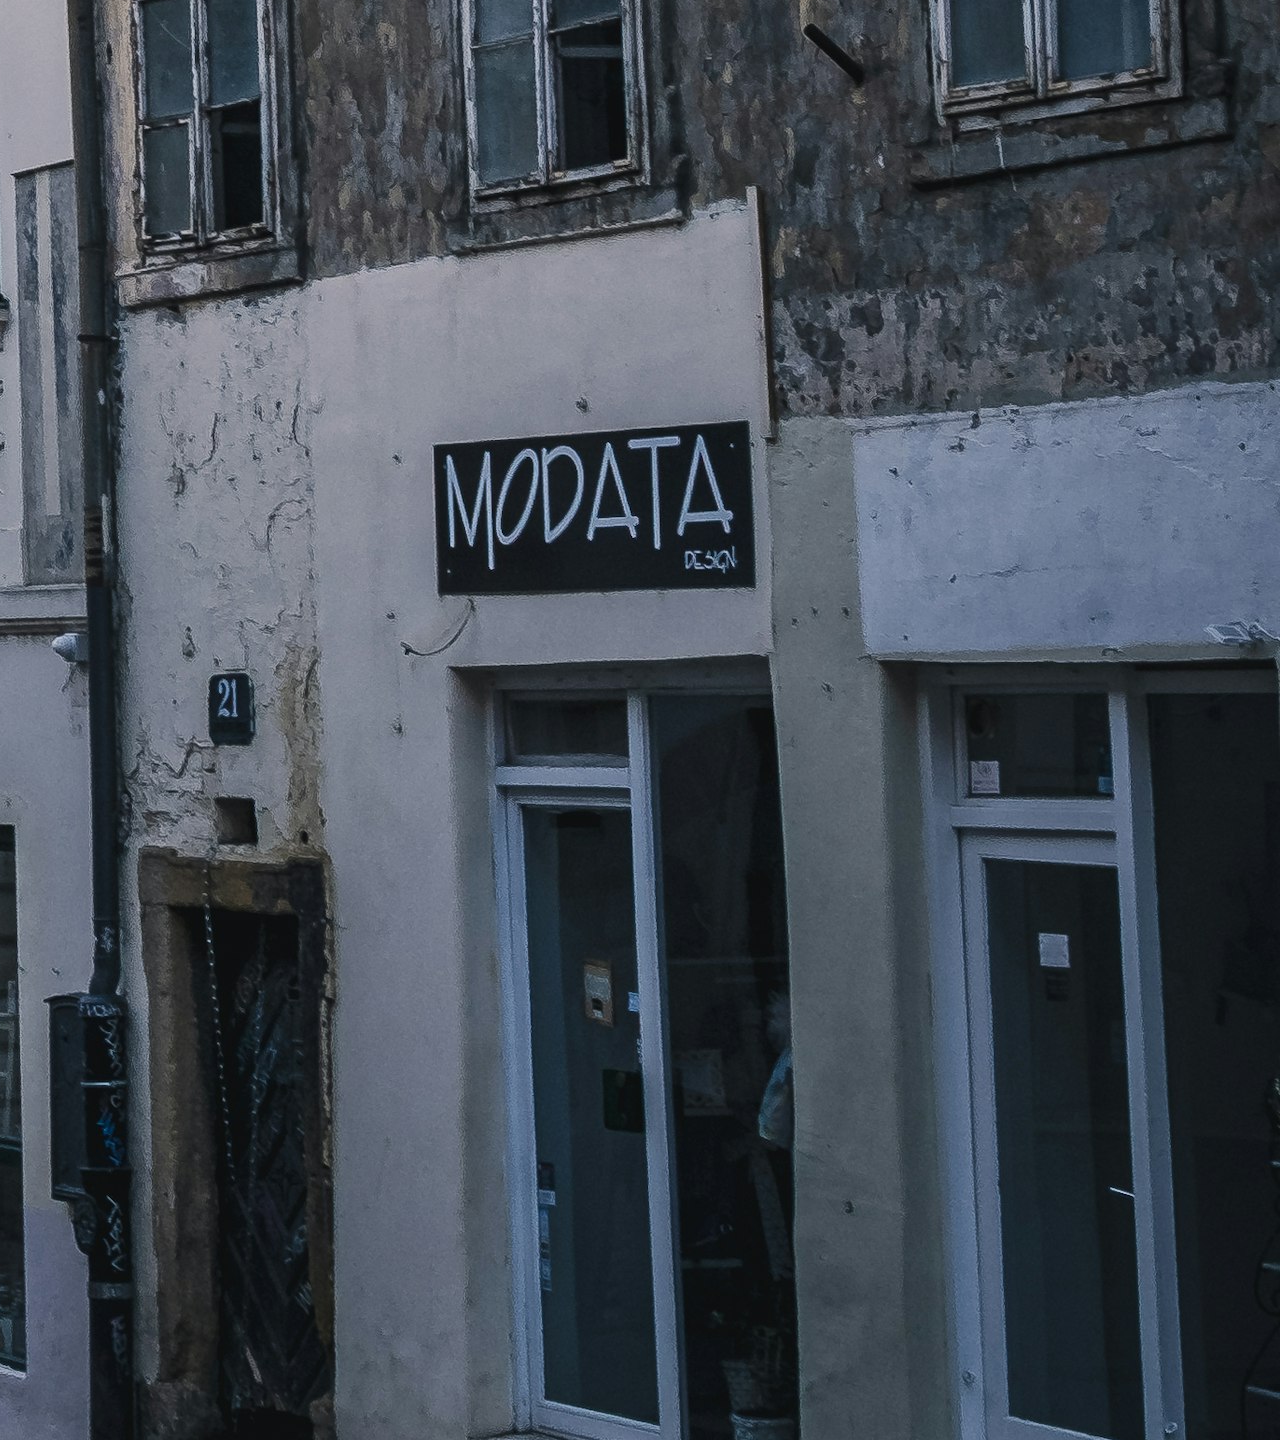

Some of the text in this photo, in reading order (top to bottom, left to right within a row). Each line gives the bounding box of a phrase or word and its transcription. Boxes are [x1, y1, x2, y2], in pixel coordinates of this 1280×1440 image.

[446, 434, 734, 572] MODATA
[684, 545, 737, 574] DESIGN
[217, 678, 238, 718] 21
